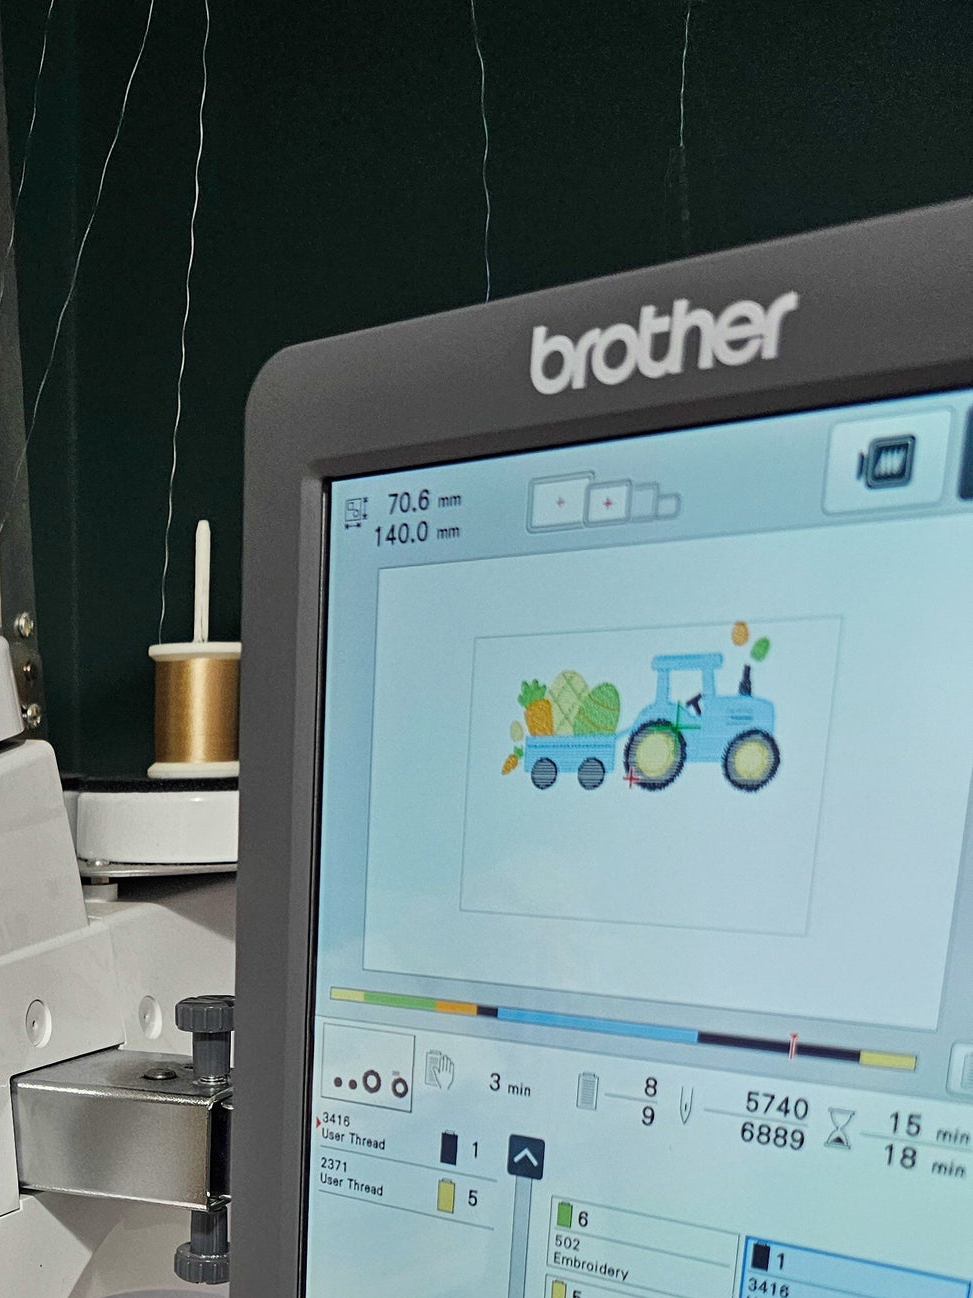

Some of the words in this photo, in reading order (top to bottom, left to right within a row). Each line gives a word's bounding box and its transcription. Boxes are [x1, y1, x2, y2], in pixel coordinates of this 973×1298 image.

[530, 290, 799, 395] brother
[388, 489, 430, 515] 70.6
[438, 495, 462, 508] mm
[375, 520, 429, 547] 140.0
[436, 526, 460, 540] mm
[489, 1073, 501, 1092] 3
[507, 1081, 531, 1097] min
[644, 1077, 658, 1097] 8
[641, 1106, 655, 1126] 9
[745, 1091, 809, 1120] 5740
[322, 1112, 350, 1127] 3416
[888, 1111, 922, 1137] 15
[936, 1125, 971, 1146] min
[322, 1128, 345, 1143] User
[349, 1133, 386, 1150] Thread
[740, 1121, 806, 1150] 6889
[472, 1141, 479, 1159] 1
[884, 1142, 917, 1170] 18
[931, 1159, 966, 1179] min
[320, 1157, 348, 1173] 2371
[320, 1172, 345, 1188] User
[347, 1178, 384, 1197] Thread
[468, 1189, 479, 1207] 5
[578, 1211, 589, 1227] 6
[555, 1235, 581, 1251] 502
[553, 1251, 629, 1281] Embroidery
[776, 1253, 785, 1270] 1
[748, 1278, 790, 1298] 3416
